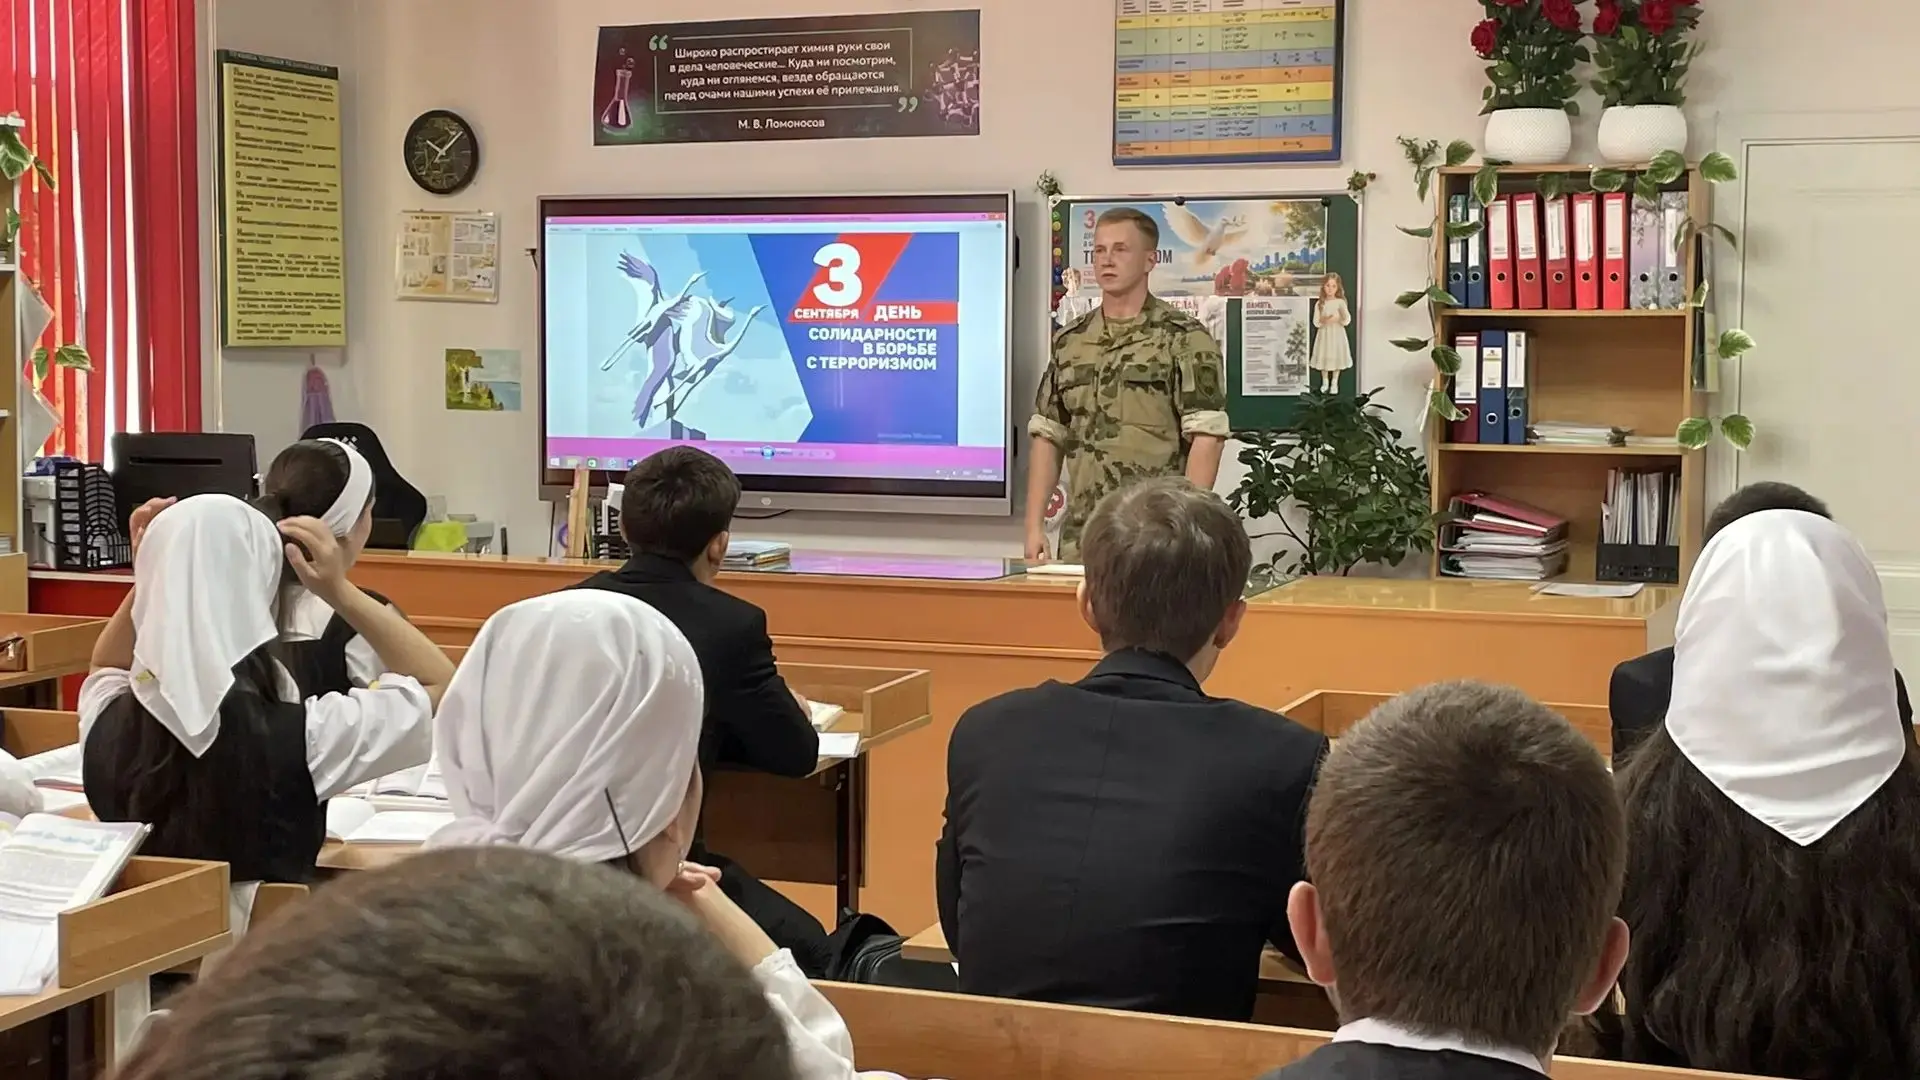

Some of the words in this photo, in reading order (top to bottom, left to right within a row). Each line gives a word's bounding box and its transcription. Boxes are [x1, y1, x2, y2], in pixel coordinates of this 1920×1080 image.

[674, 48, 718, 59] Широко
[720, 45, 799, 59] распростирает
[801, 44, 834, 54] химия
[837, 43, 862, 54] руки
[865, 42, 891, 51] свои
[669, 65, 676, 73] в
[678, 63, 703, 74] дела
[788, 58, 814, 70] Куда
[816, 59, 831, 68] ни
[833, 56, 896, 67] посмотрим,
[680, 77, 705, 88] куда
[707, 76, 721, 85] ни
[722, 74, 780, 85] оглянемся,
[782, 73, 813, 83] везде
[815, 70, 885, 83] обращаются
[664, 91, 697, 102] перед
[698, 90, 731, 99] очами
[733, 88, 776, 99] нашими
[778, 87, 814, 99] успехи
[816, 85, 829, 96] её
[831, 84, 902, 97] прилежания.
[738, 119, 751, 129] М.
[753, 119, 763, 129] В.
[765, 118, 826, 129] Ломоносов
[813, 242, 863, 307] 3
[794, 308, 860, 319] СЕНТЯБРЯ
[873, 304, 922, 321] ДЕНЬ
[808, 327, 937, 343] СОЛИДАРНОСТИ
[862, 342, 874, 355] В
[875, 342, 937, 355] БОРЬБЕ
[806, 355, 818, 369] С
[818, 356, 937, 370] ТЕРРОРИЗМОМ
